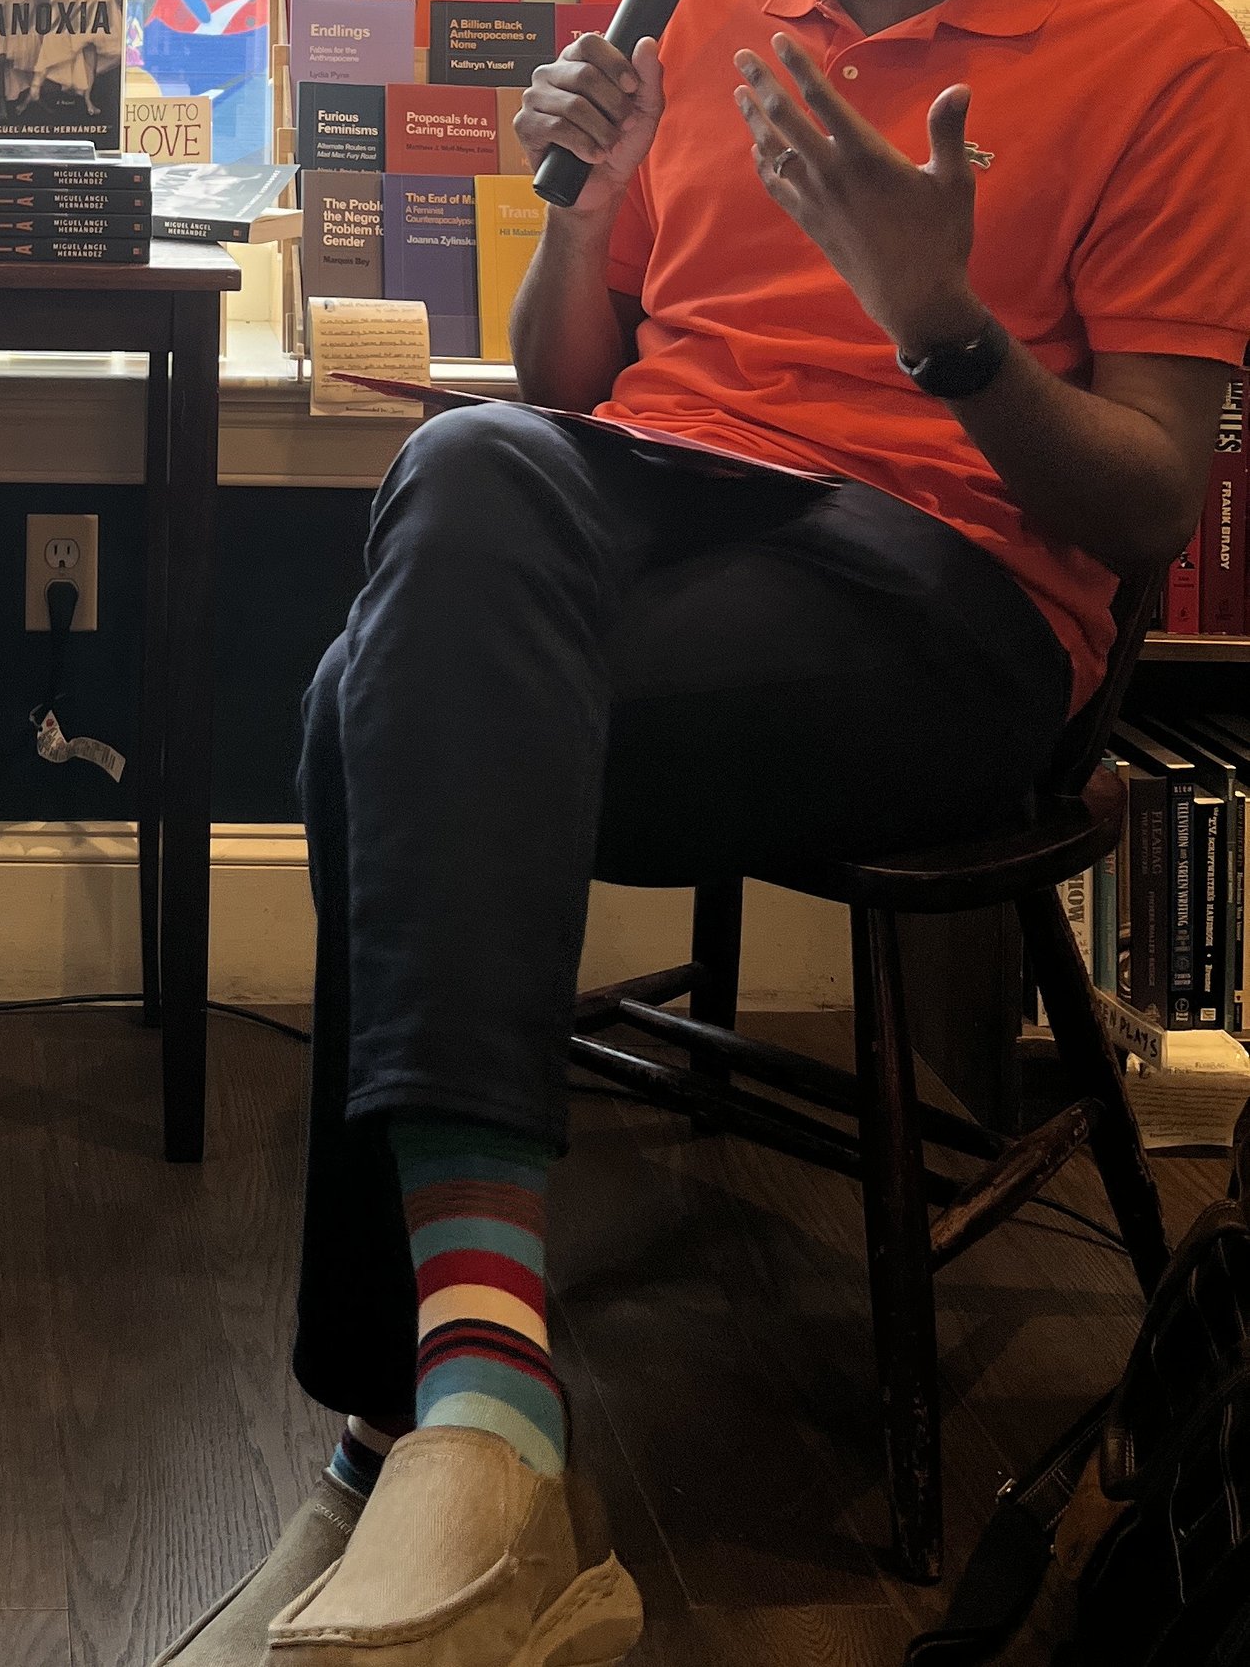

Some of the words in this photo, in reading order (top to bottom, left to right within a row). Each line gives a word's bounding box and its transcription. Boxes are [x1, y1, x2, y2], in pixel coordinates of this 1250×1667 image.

[450, 19, 458, 29] A
[461, 19, 492, 29] Billion
[494, 20, 523, 30] Black
[310, 23, 371, 41] Endlings
[450, 30, 524, 41] Anthropocenes
[526, 32, 537, 41] or
[450, 40, 477, 50] None
[451, 60, 485, 71] Kathryn
[487, 60, 514, 70] Yusoff
[125, 103, 167, 122] HOW
[173, 103, 199, 122] TO
[317, 110, 359, 123] Furious
[406, 111, 461, 126] Proposals
[463, 114, 479, 125] for
[481, 117, 487, 126] a
[317, 123, 379, 136] Feminisms
[406, 124, 444, 138] Caring
[447, 126, 497, 140] Economy
[123, 123, 202, 157] LOVE
[323, 197, 347, 210] The
[405, 192, 426, 203] The
[428, 193, 447, 204] End
[450, 193, 460, 204] of
[323, 210, 342, 222] the
[344, 211, 380, 226] Negro
[498, 204, 540, 219] Trans
[323, 222, 372, 235] Problem
[323, 235, 366, 248] Gender
[406, 234, 439, 246] Joanna
[440, 235, 477, 247] Zylinska
[1221, 481, 1232, 525] FRANK
[1220, 526, 1231, 571] BRADY
